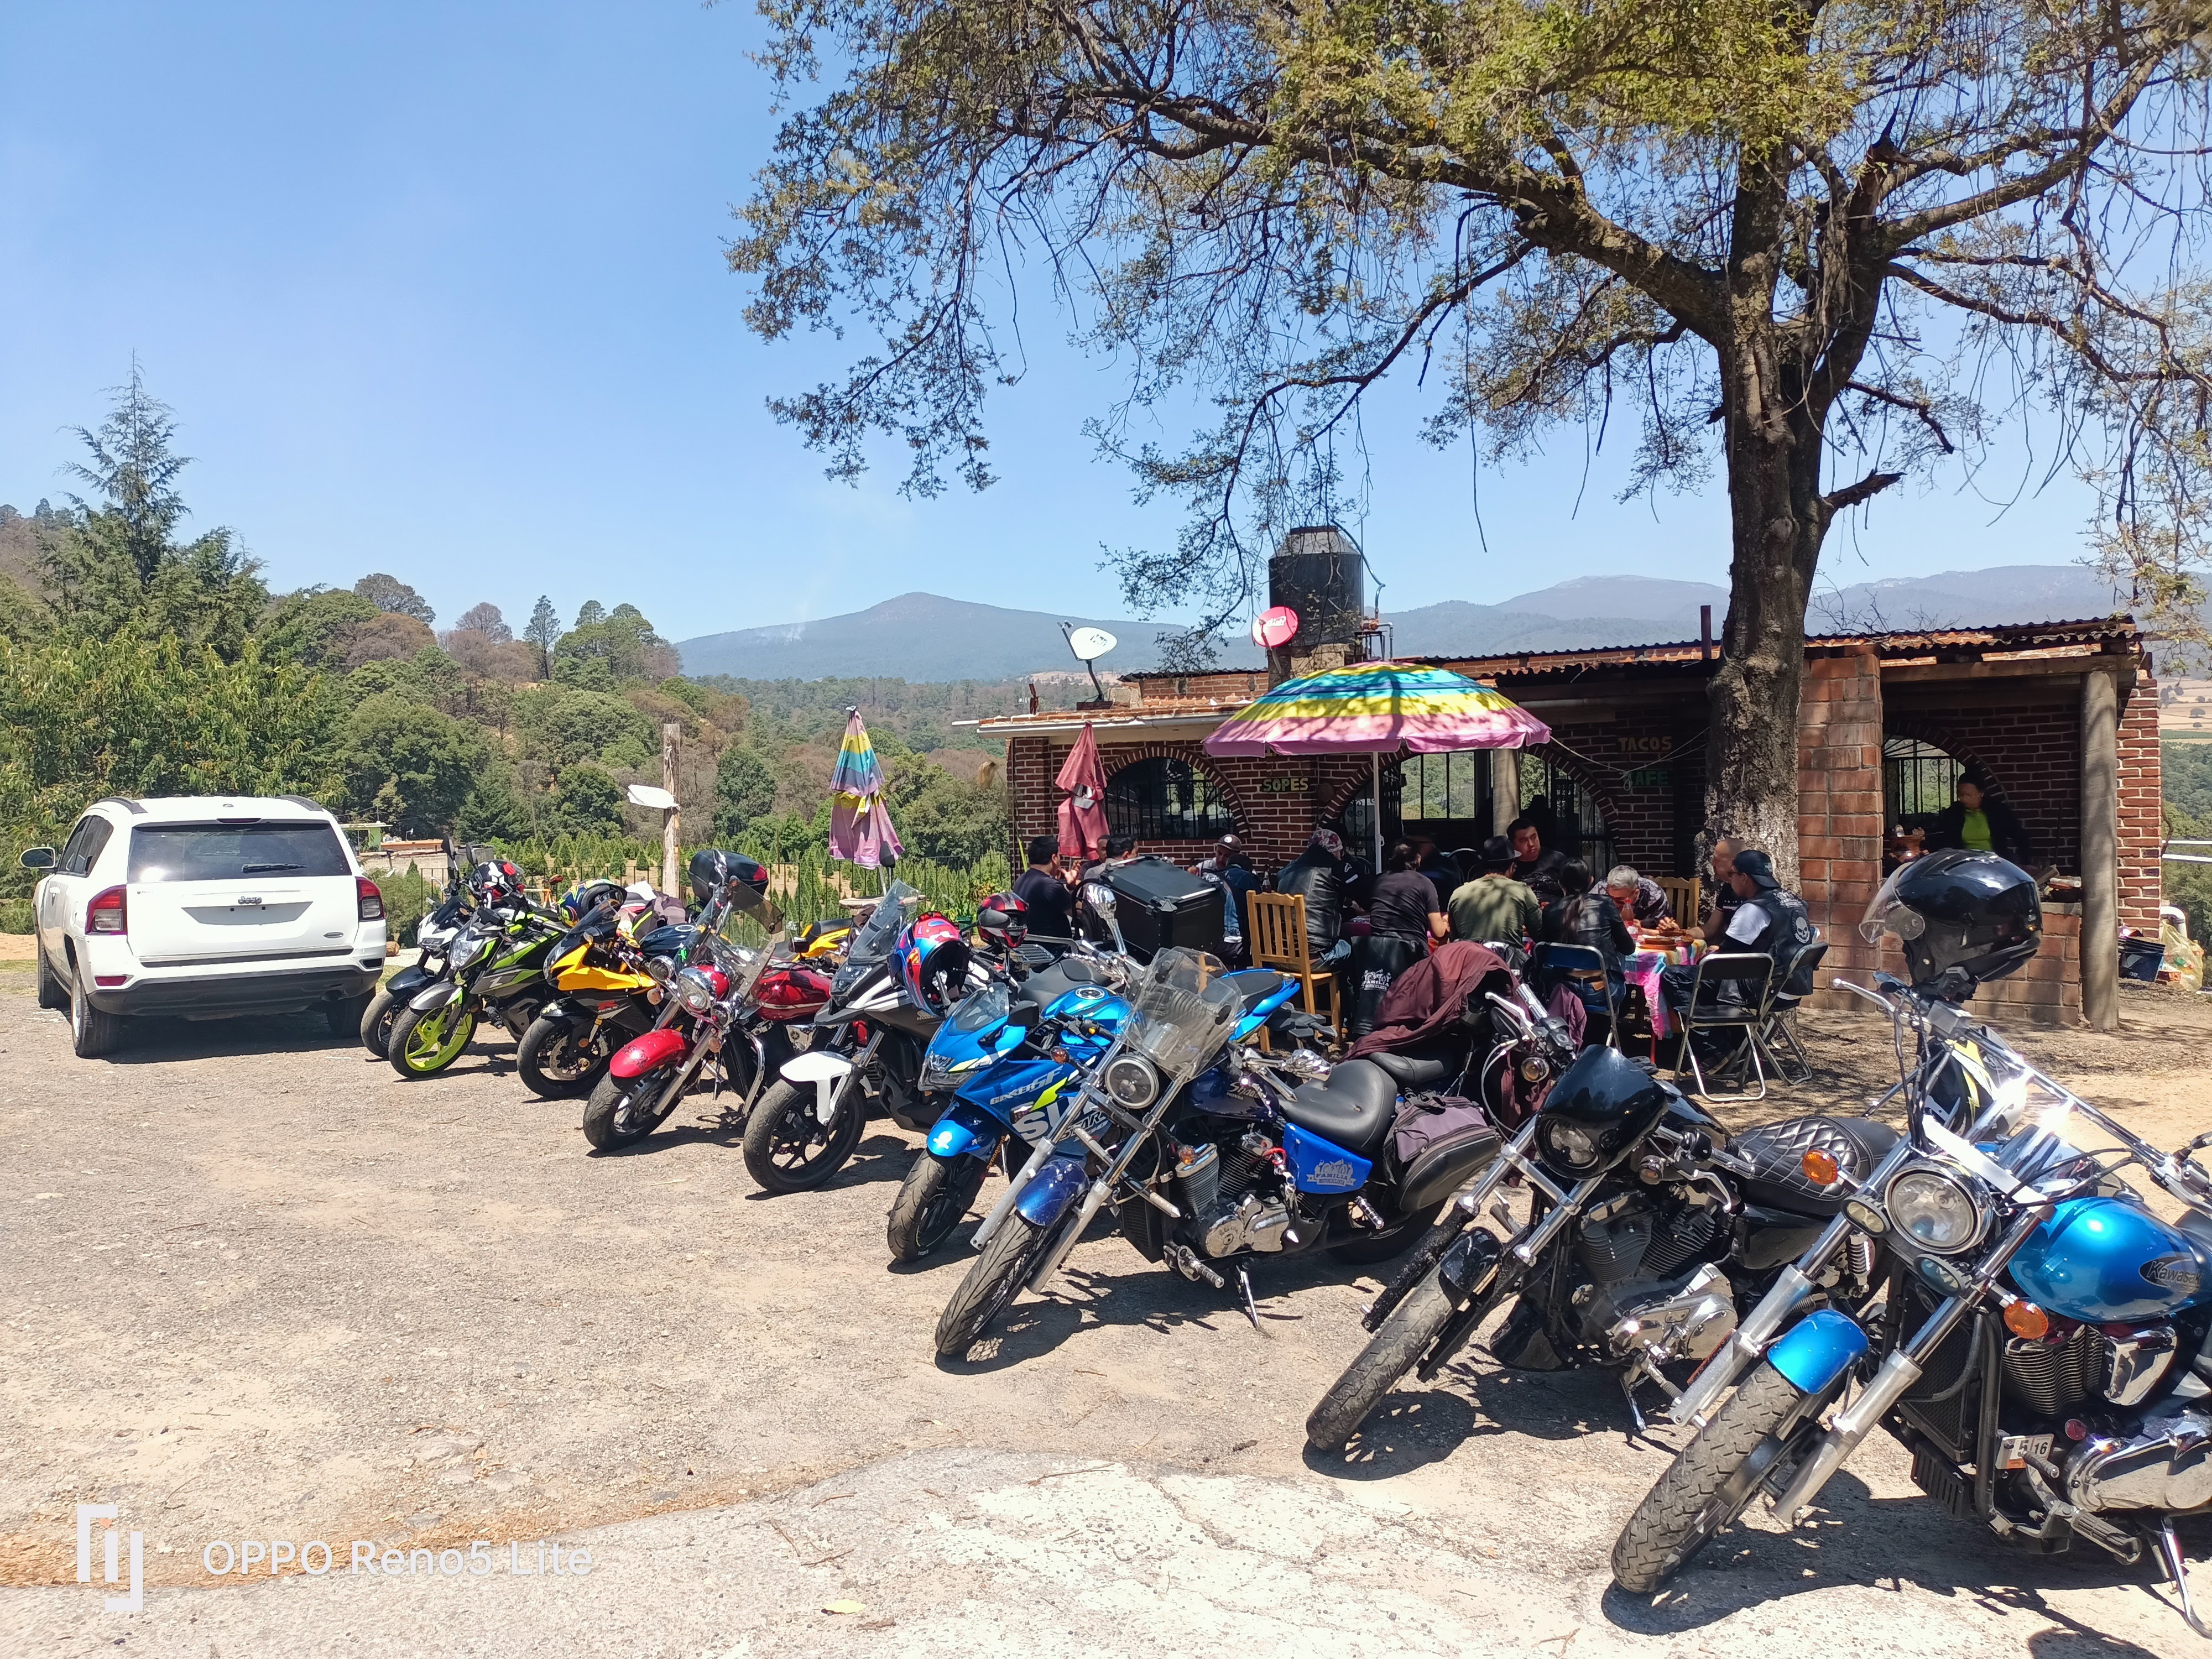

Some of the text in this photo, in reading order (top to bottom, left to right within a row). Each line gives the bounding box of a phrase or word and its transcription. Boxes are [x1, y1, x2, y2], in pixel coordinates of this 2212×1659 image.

[1618, 736, 1672, 752] TACOS
[1263, 778, 1308, 791] SOPES
[237, 895, 262, 905] Jeep
[1226, 1092, 1244, 1100] HONDA
[2034, 1442, 2048, 1455] 16
